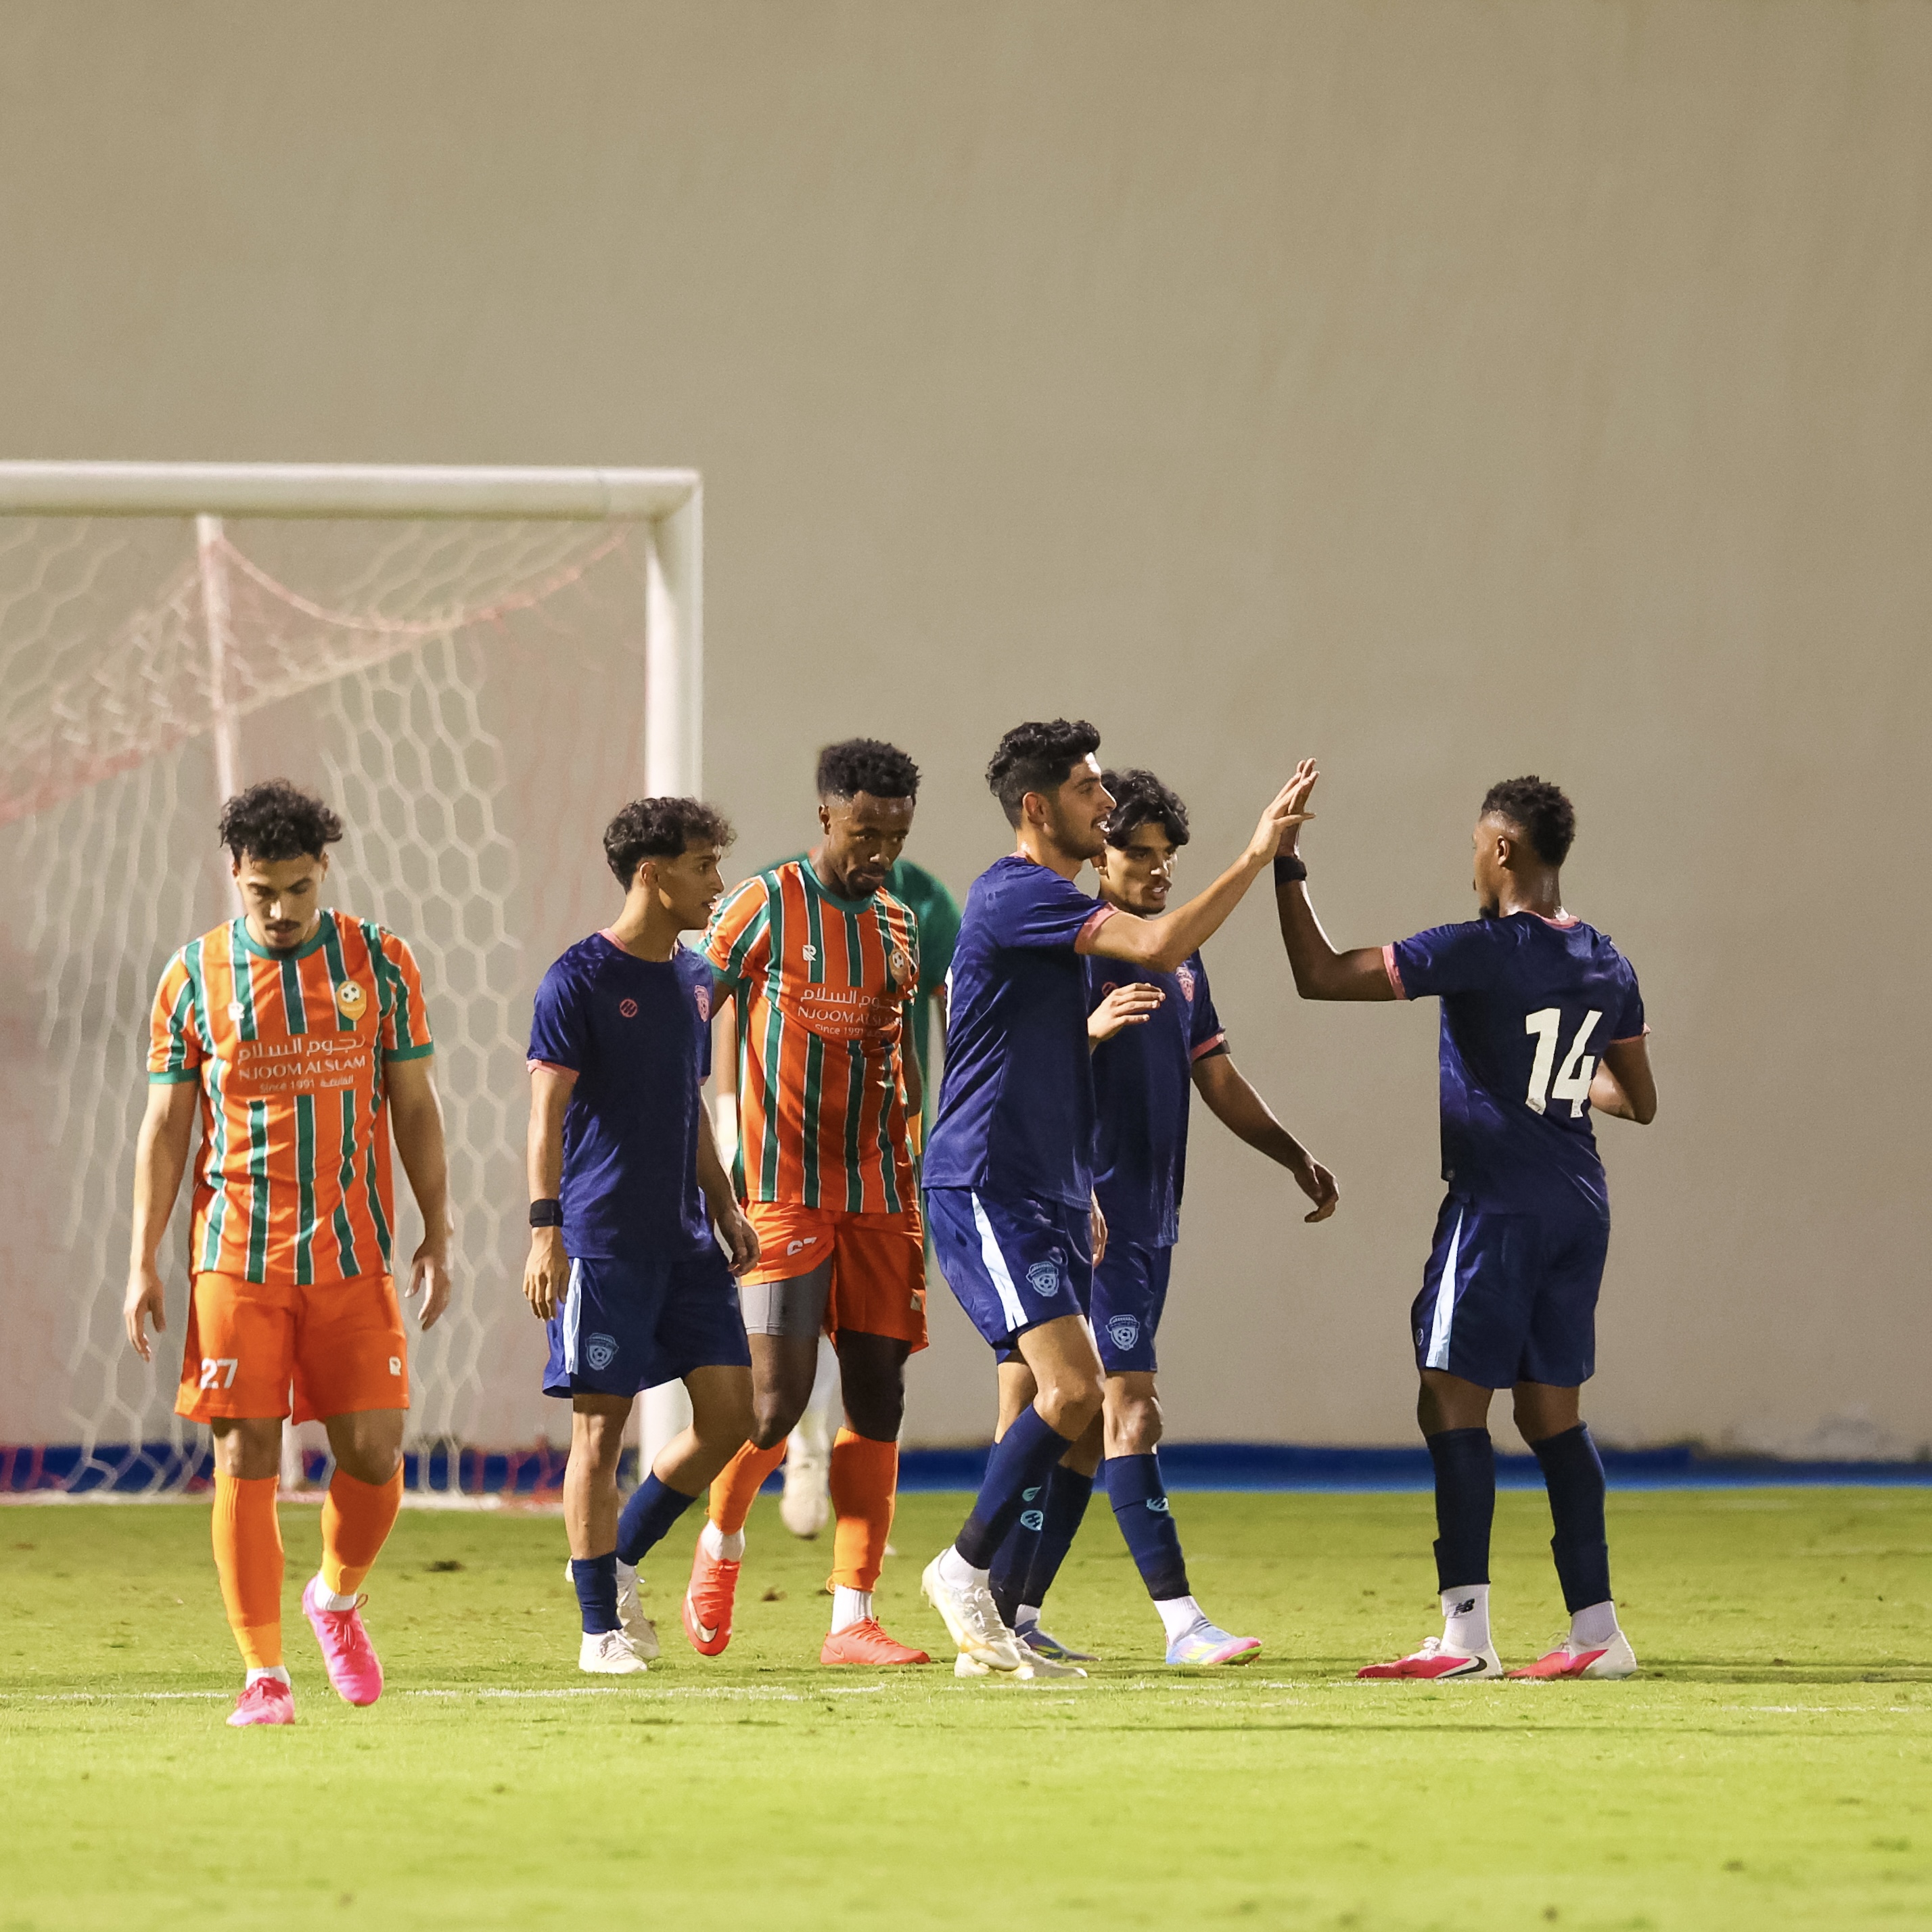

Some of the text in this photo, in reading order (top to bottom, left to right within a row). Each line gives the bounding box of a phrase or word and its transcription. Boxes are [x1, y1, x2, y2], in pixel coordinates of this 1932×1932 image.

[798, 1006, 854, 1024] NJOOM
[239, 1062, 302, 1081] NJOOM
[1525, 1007, 1603, 1118] 14
[200, 1357, 238, 1389] 27
